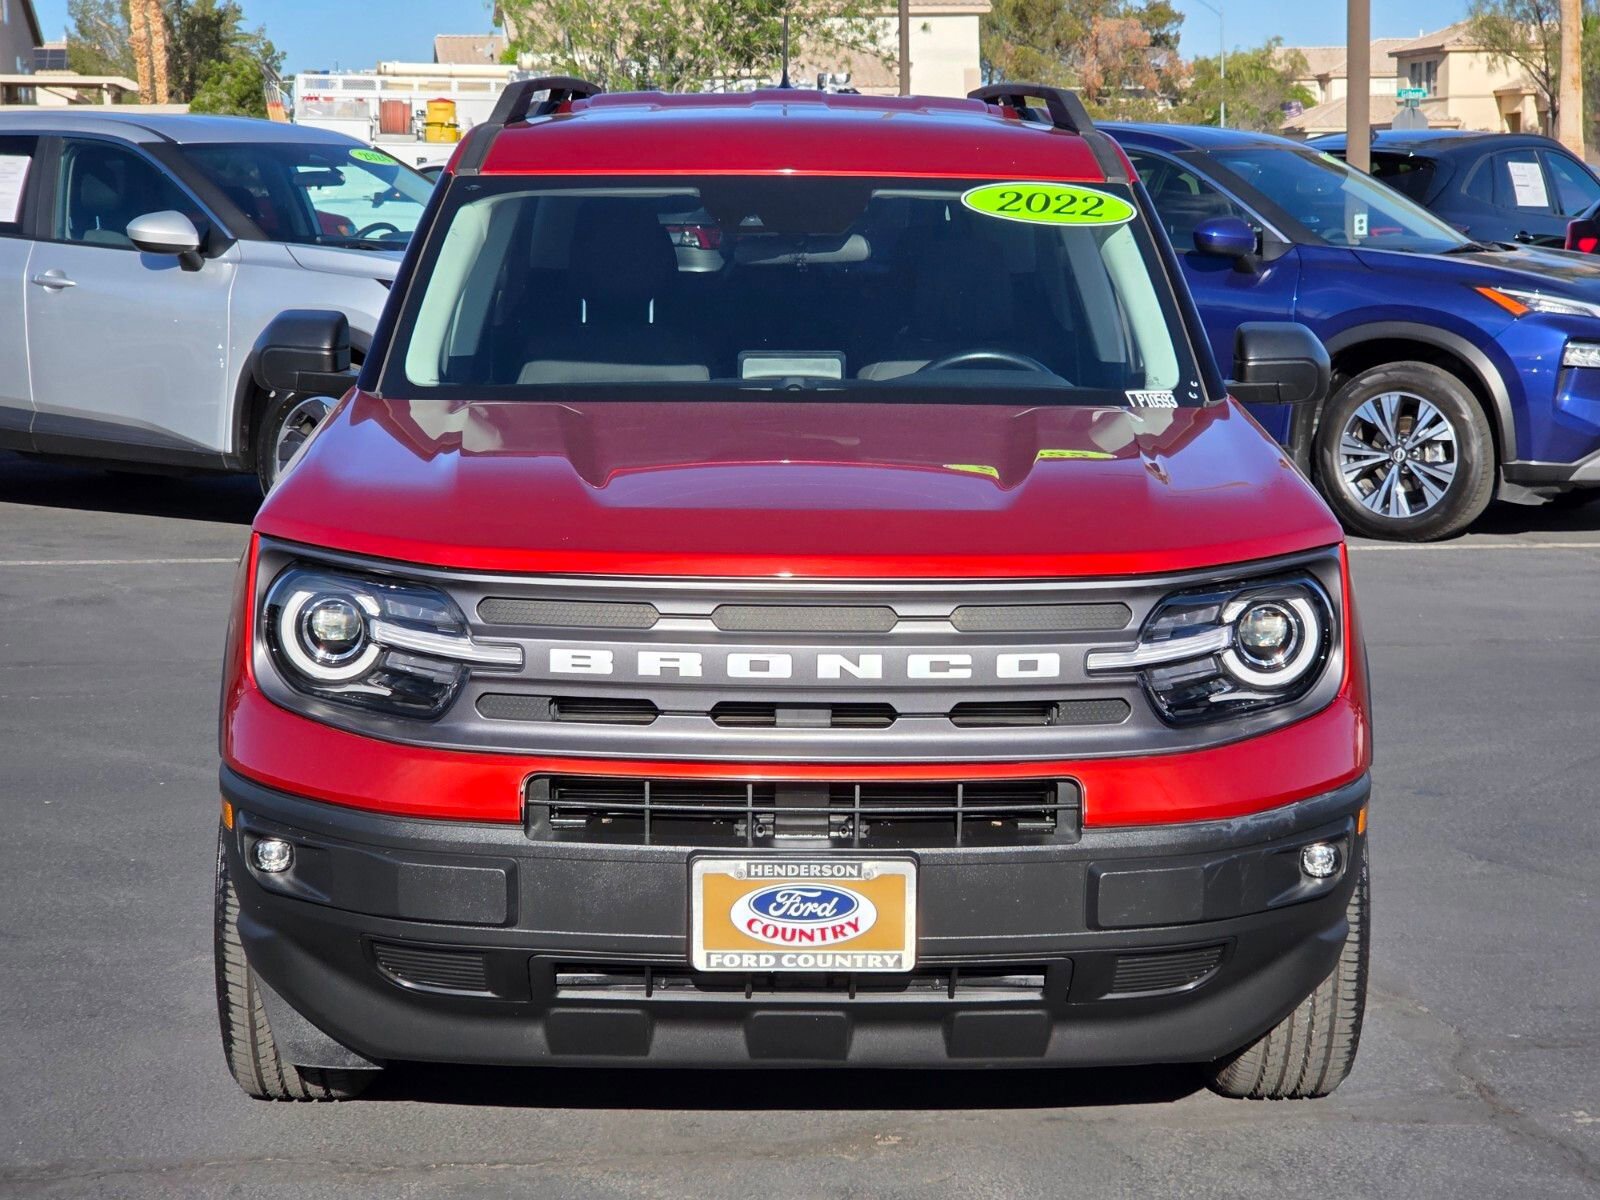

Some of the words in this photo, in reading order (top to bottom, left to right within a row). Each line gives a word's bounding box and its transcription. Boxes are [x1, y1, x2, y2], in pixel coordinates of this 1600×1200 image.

[996, 191, 1105, 217] 2022
[549, 648, 1060, 679] BRONCO
[750, 864, 859, 877] HENDERSON
[768, 889, 839, 918] Ford
[746, 916, 860, 943] COUNTRY
[709, 953, 777, 969] FORD
[781, 953, 899, 969] COUNTRY
